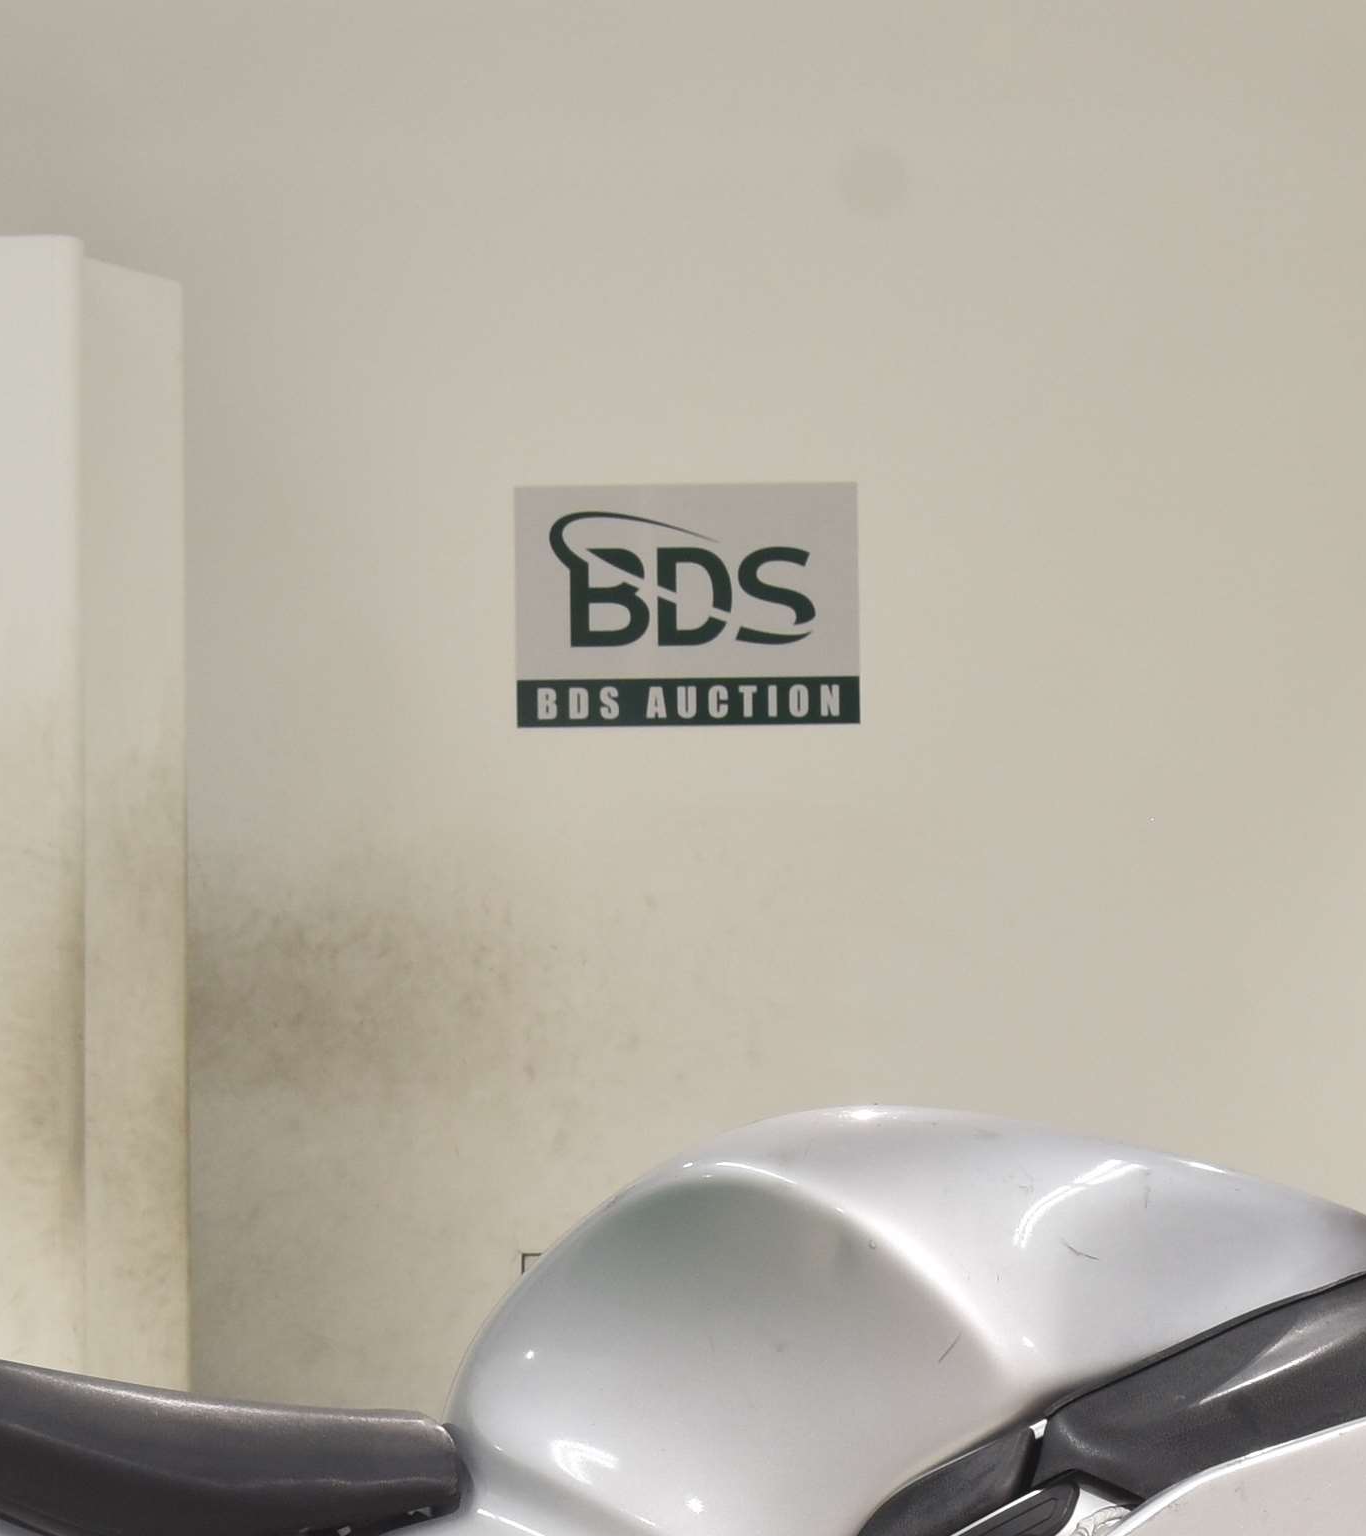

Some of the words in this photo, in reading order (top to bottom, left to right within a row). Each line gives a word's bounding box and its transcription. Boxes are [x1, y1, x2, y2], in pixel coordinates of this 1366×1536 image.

[549, 512, 816, 648] BDS
[537, 687, 620, 720] BDS
[646, 684, 841, 718] AUCTION
